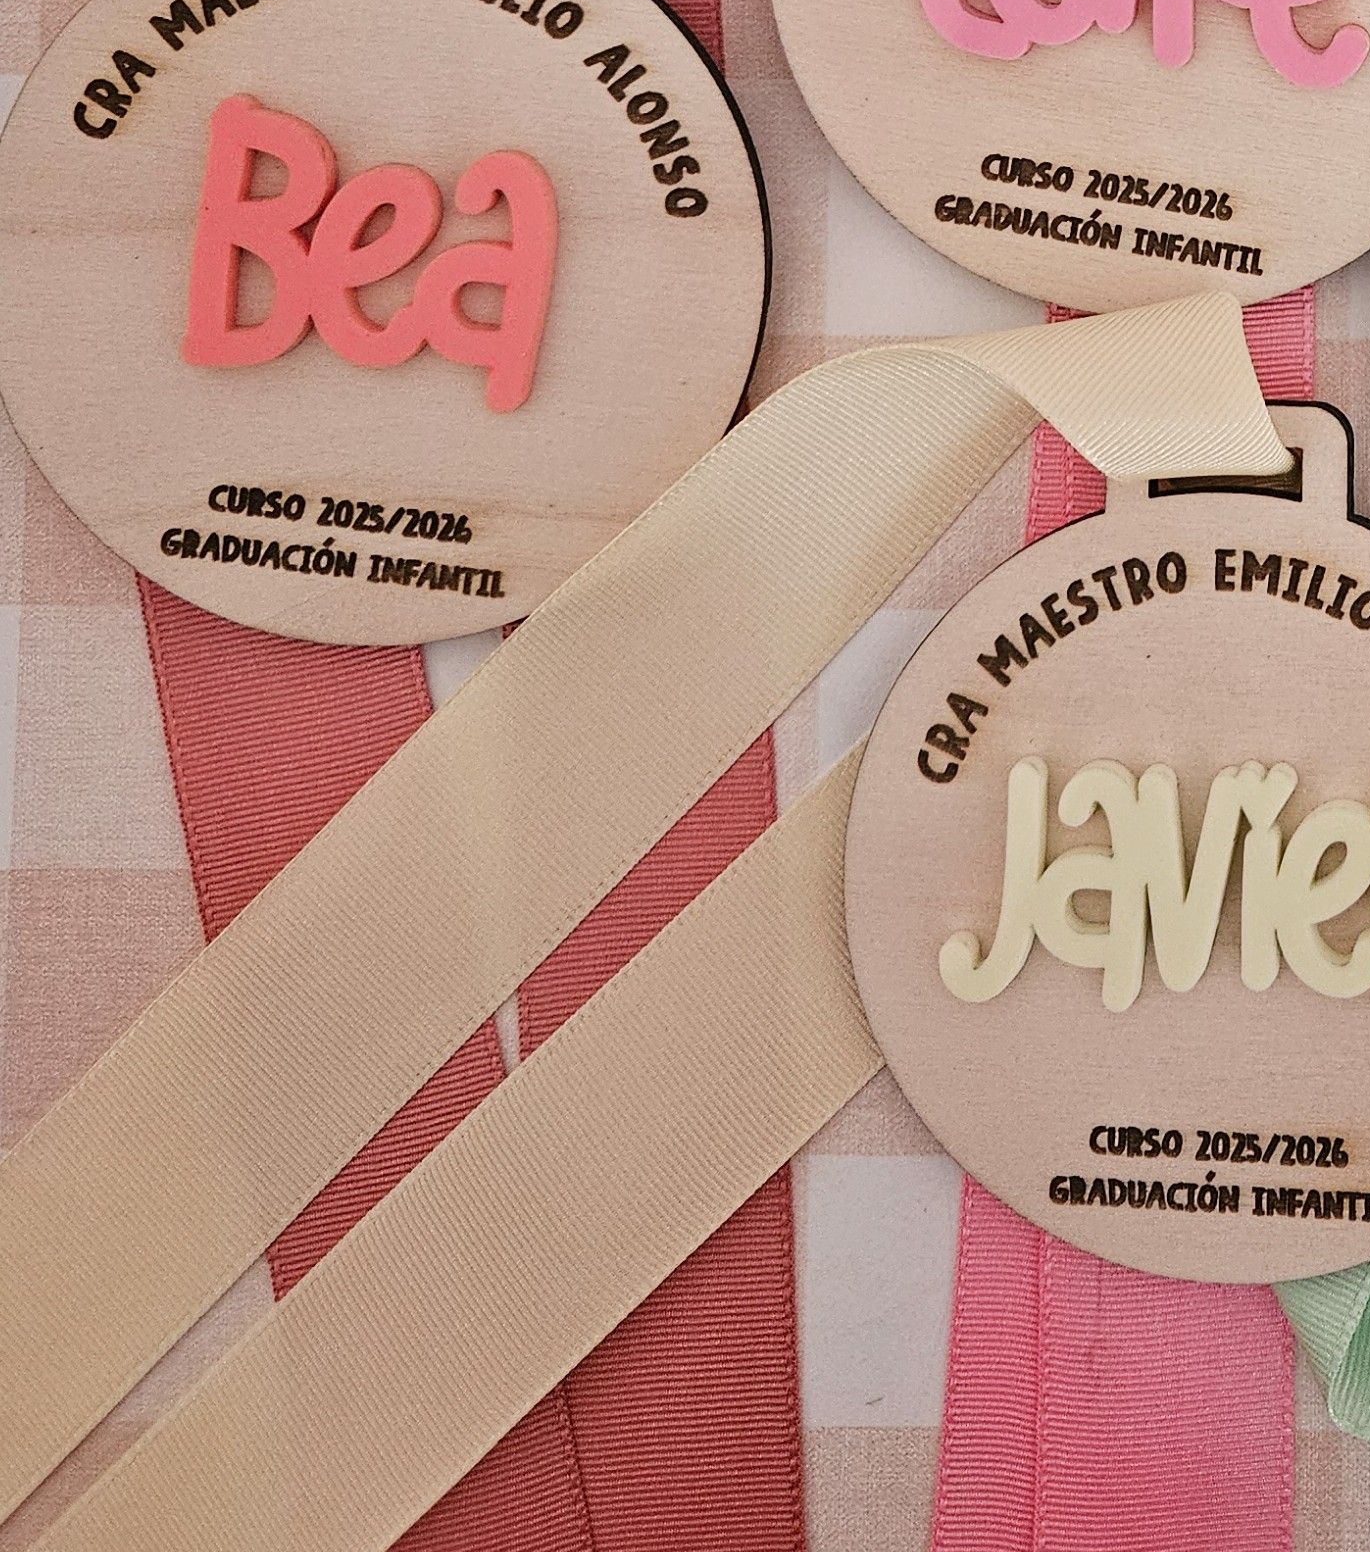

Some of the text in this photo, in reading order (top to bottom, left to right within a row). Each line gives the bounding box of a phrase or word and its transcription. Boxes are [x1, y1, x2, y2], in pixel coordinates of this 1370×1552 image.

[74, 50, 158, 139] CRA
[583, 44, 709, 218] ALONSO
[981, 154, 1233, 221] CURSO 2025/2026
[180, 92, 560, 414] Bea
[935, 194, 1263, 276] GRADUACIÓN INFANTIL
[208, 484, 472, 545] CURSO 2025/2026
[160, 528, 505, 598] GRADUACIÓN INFANTIL
[917, 692, 989, 783] CRA
[977, 551, 1187, 687] MAESTRO
[1089, 1126, 1349, 1168] CURSO 2025/2026
[1049, 1170, 1240, 1213] GRADUACIÓN
